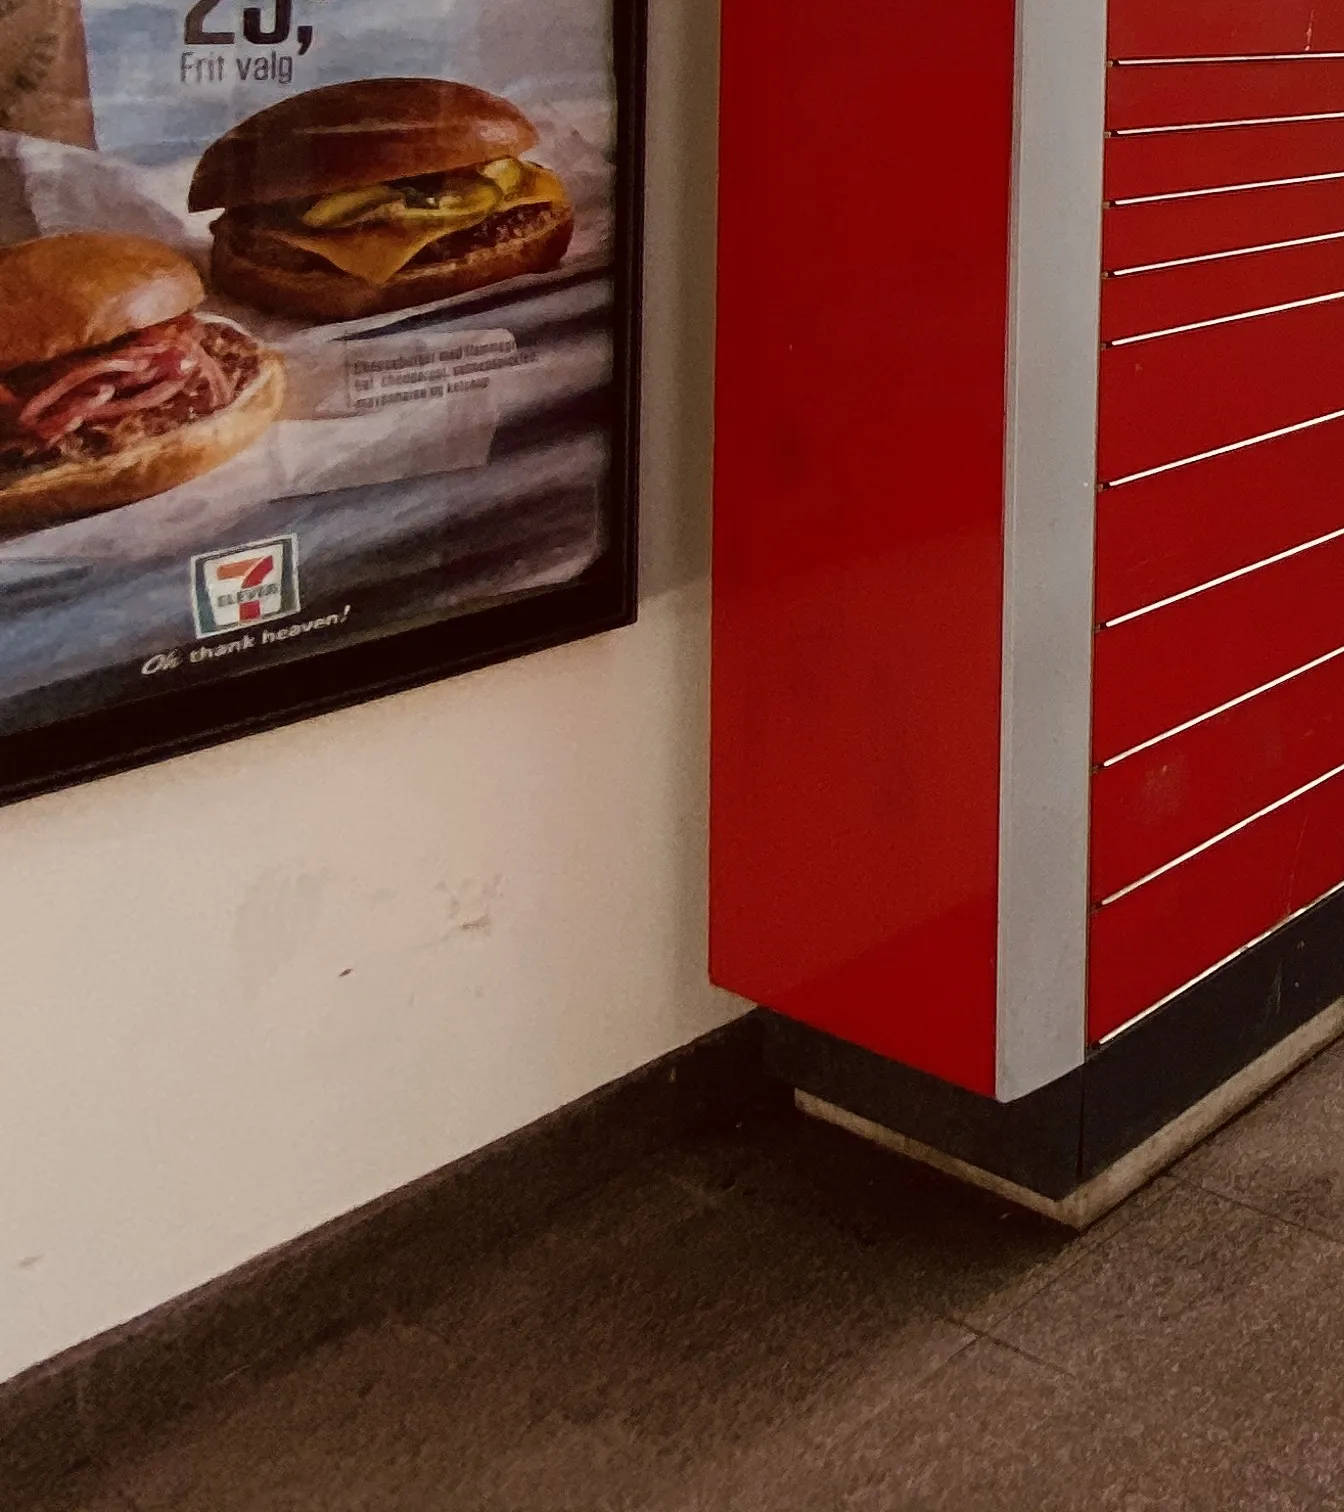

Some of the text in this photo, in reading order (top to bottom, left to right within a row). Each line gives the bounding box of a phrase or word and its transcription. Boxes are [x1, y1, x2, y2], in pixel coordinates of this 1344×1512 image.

[180, 51, 294, 85] Frit valg
[141, 604, 351, 675] Oh thank heaven!
